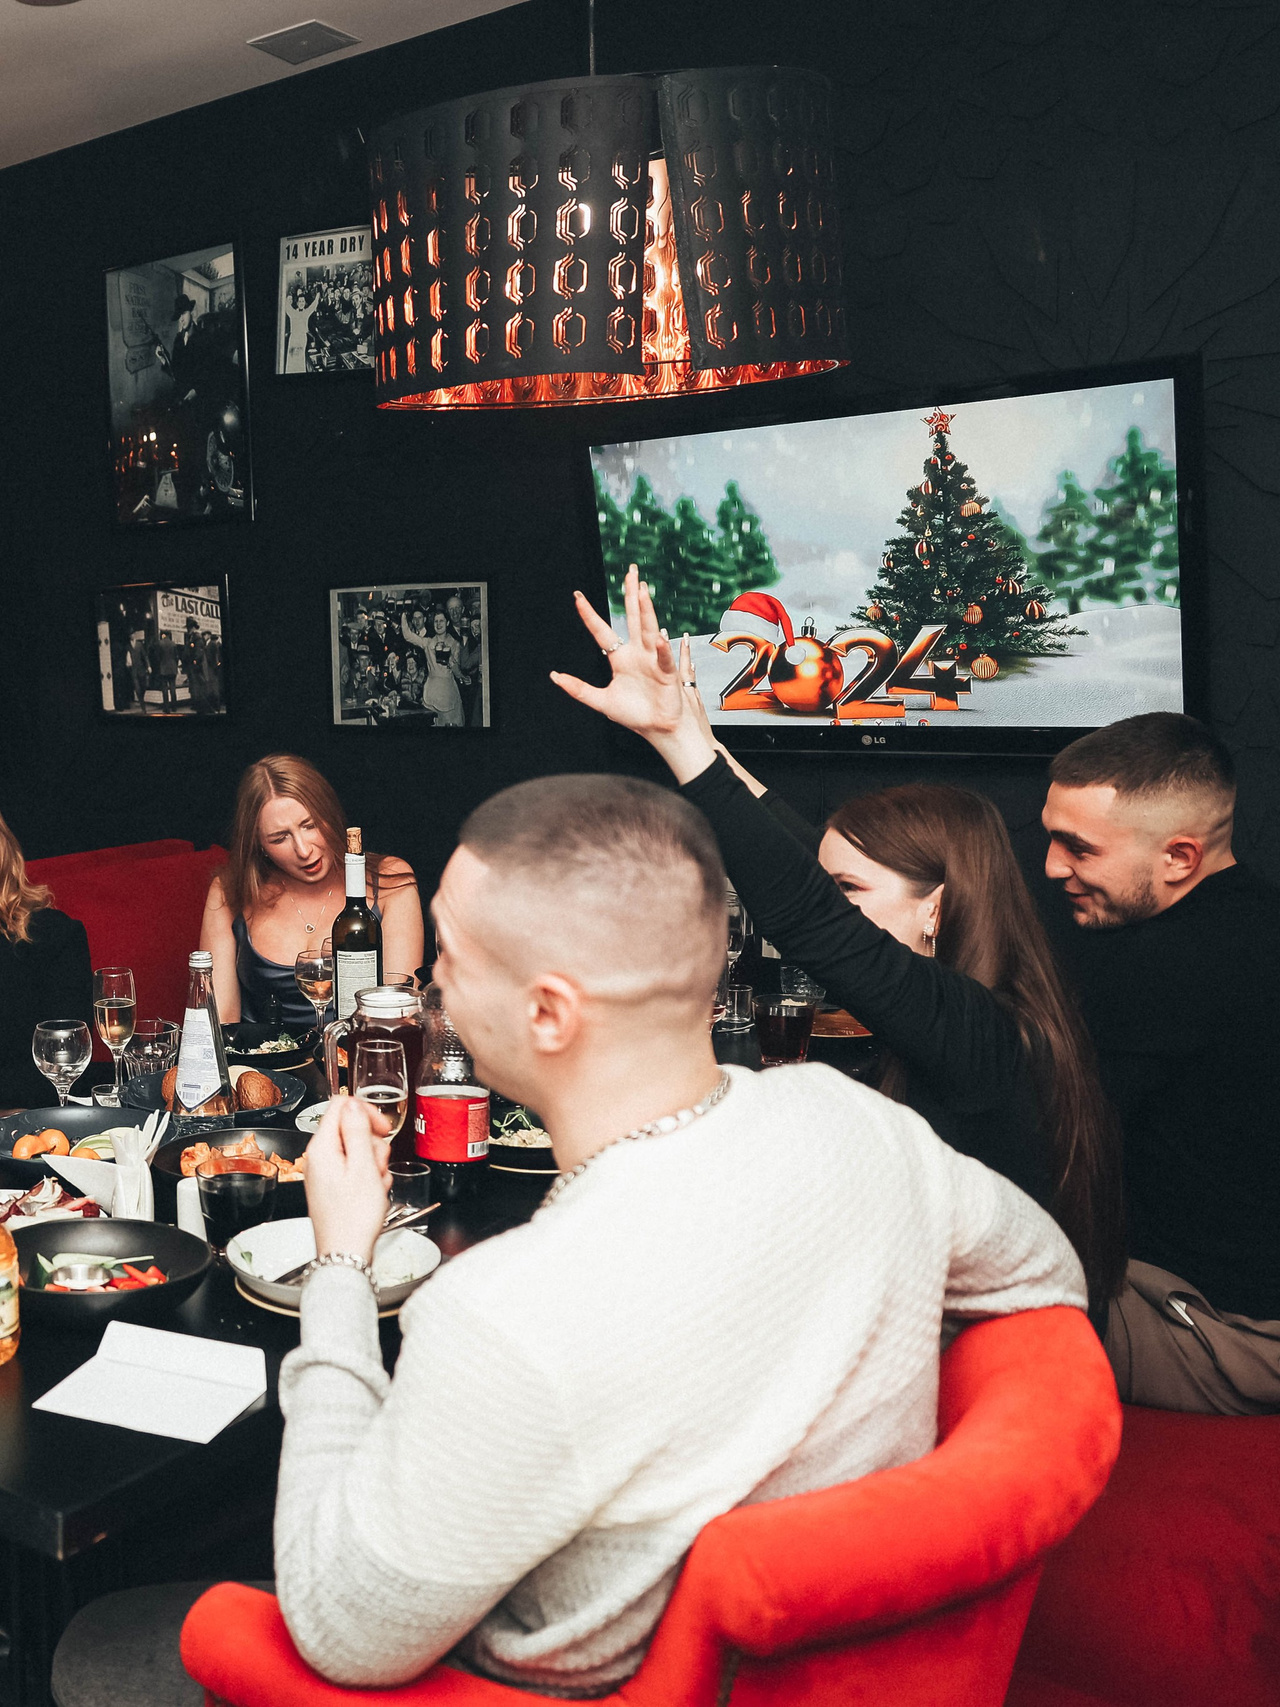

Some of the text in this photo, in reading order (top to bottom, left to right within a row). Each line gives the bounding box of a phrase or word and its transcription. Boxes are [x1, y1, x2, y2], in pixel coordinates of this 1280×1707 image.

[286, 235, 365, 260] 14 YEAR DRY
[175, 595, 199, 616] LAST
[200, 601, 220, 619] CALL
[709, 624, 972, 719] 2024
[874, 736, 886, 744] LG
